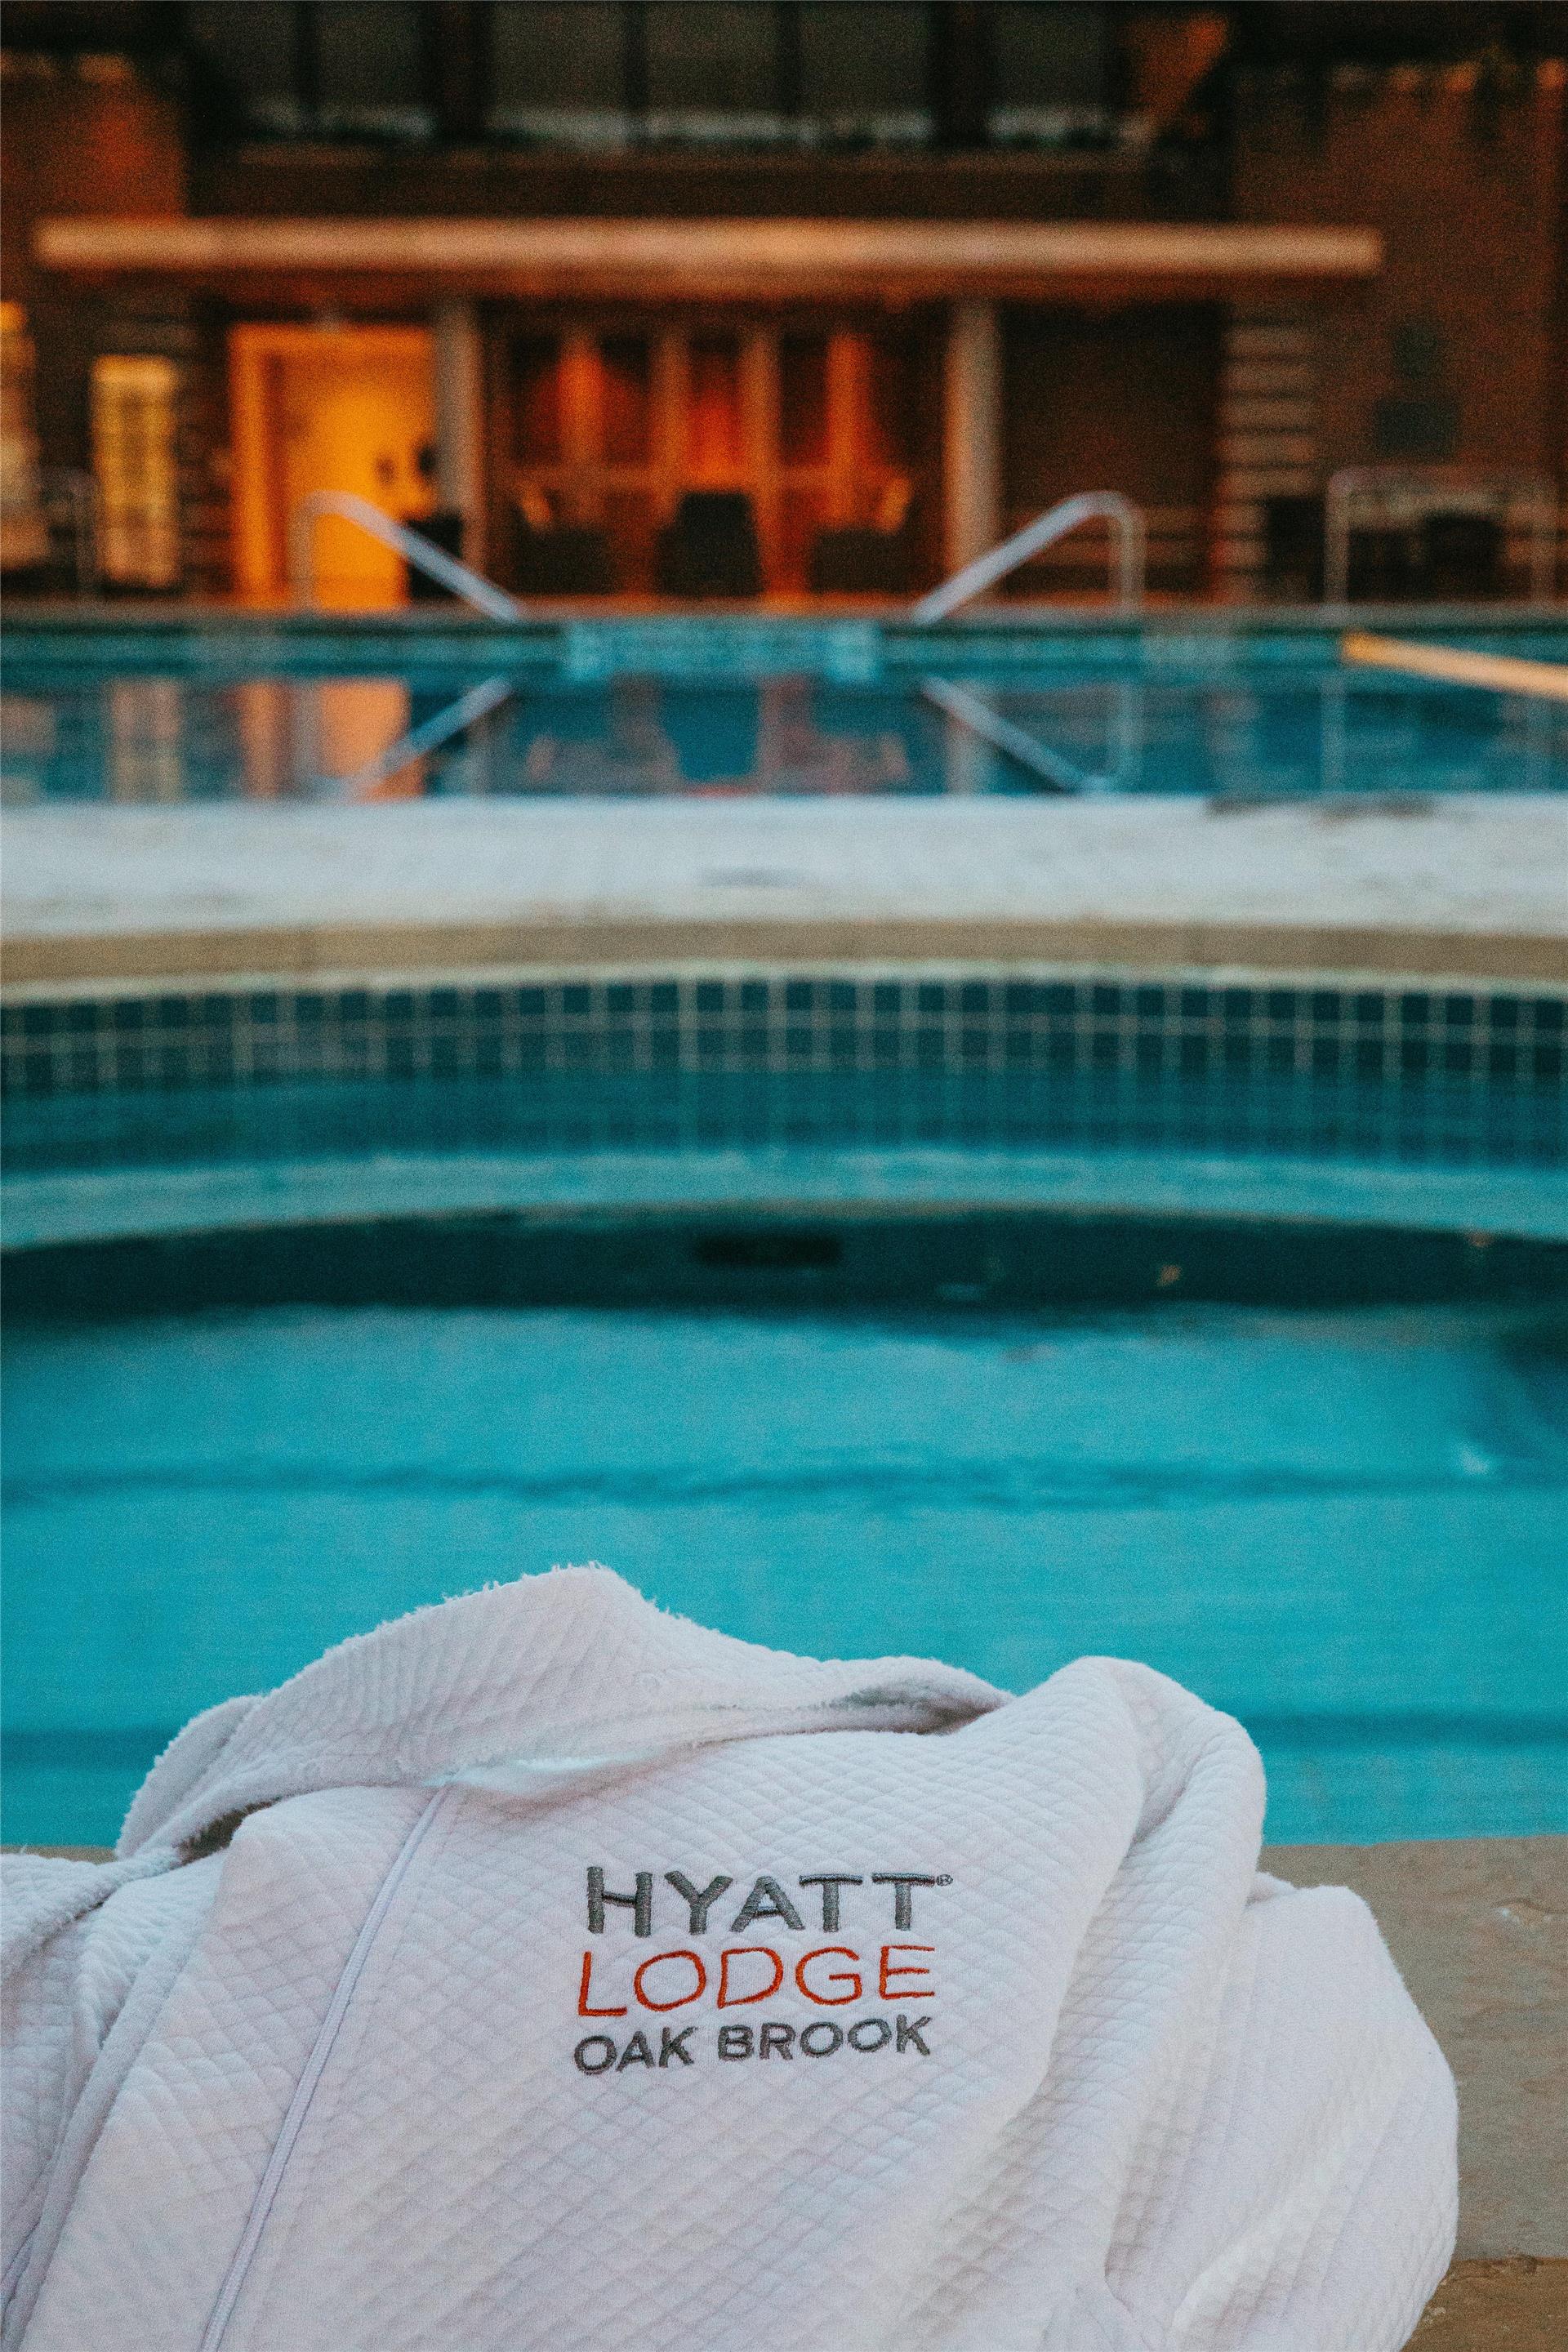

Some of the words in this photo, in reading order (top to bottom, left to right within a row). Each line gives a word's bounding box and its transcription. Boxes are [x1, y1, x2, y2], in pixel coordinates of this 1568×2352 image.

[578, 1945, 936, 2016] LODGE
[573, 2026, 698, 2074] OAK
[717, 2014, 931, 2061] BROOK
